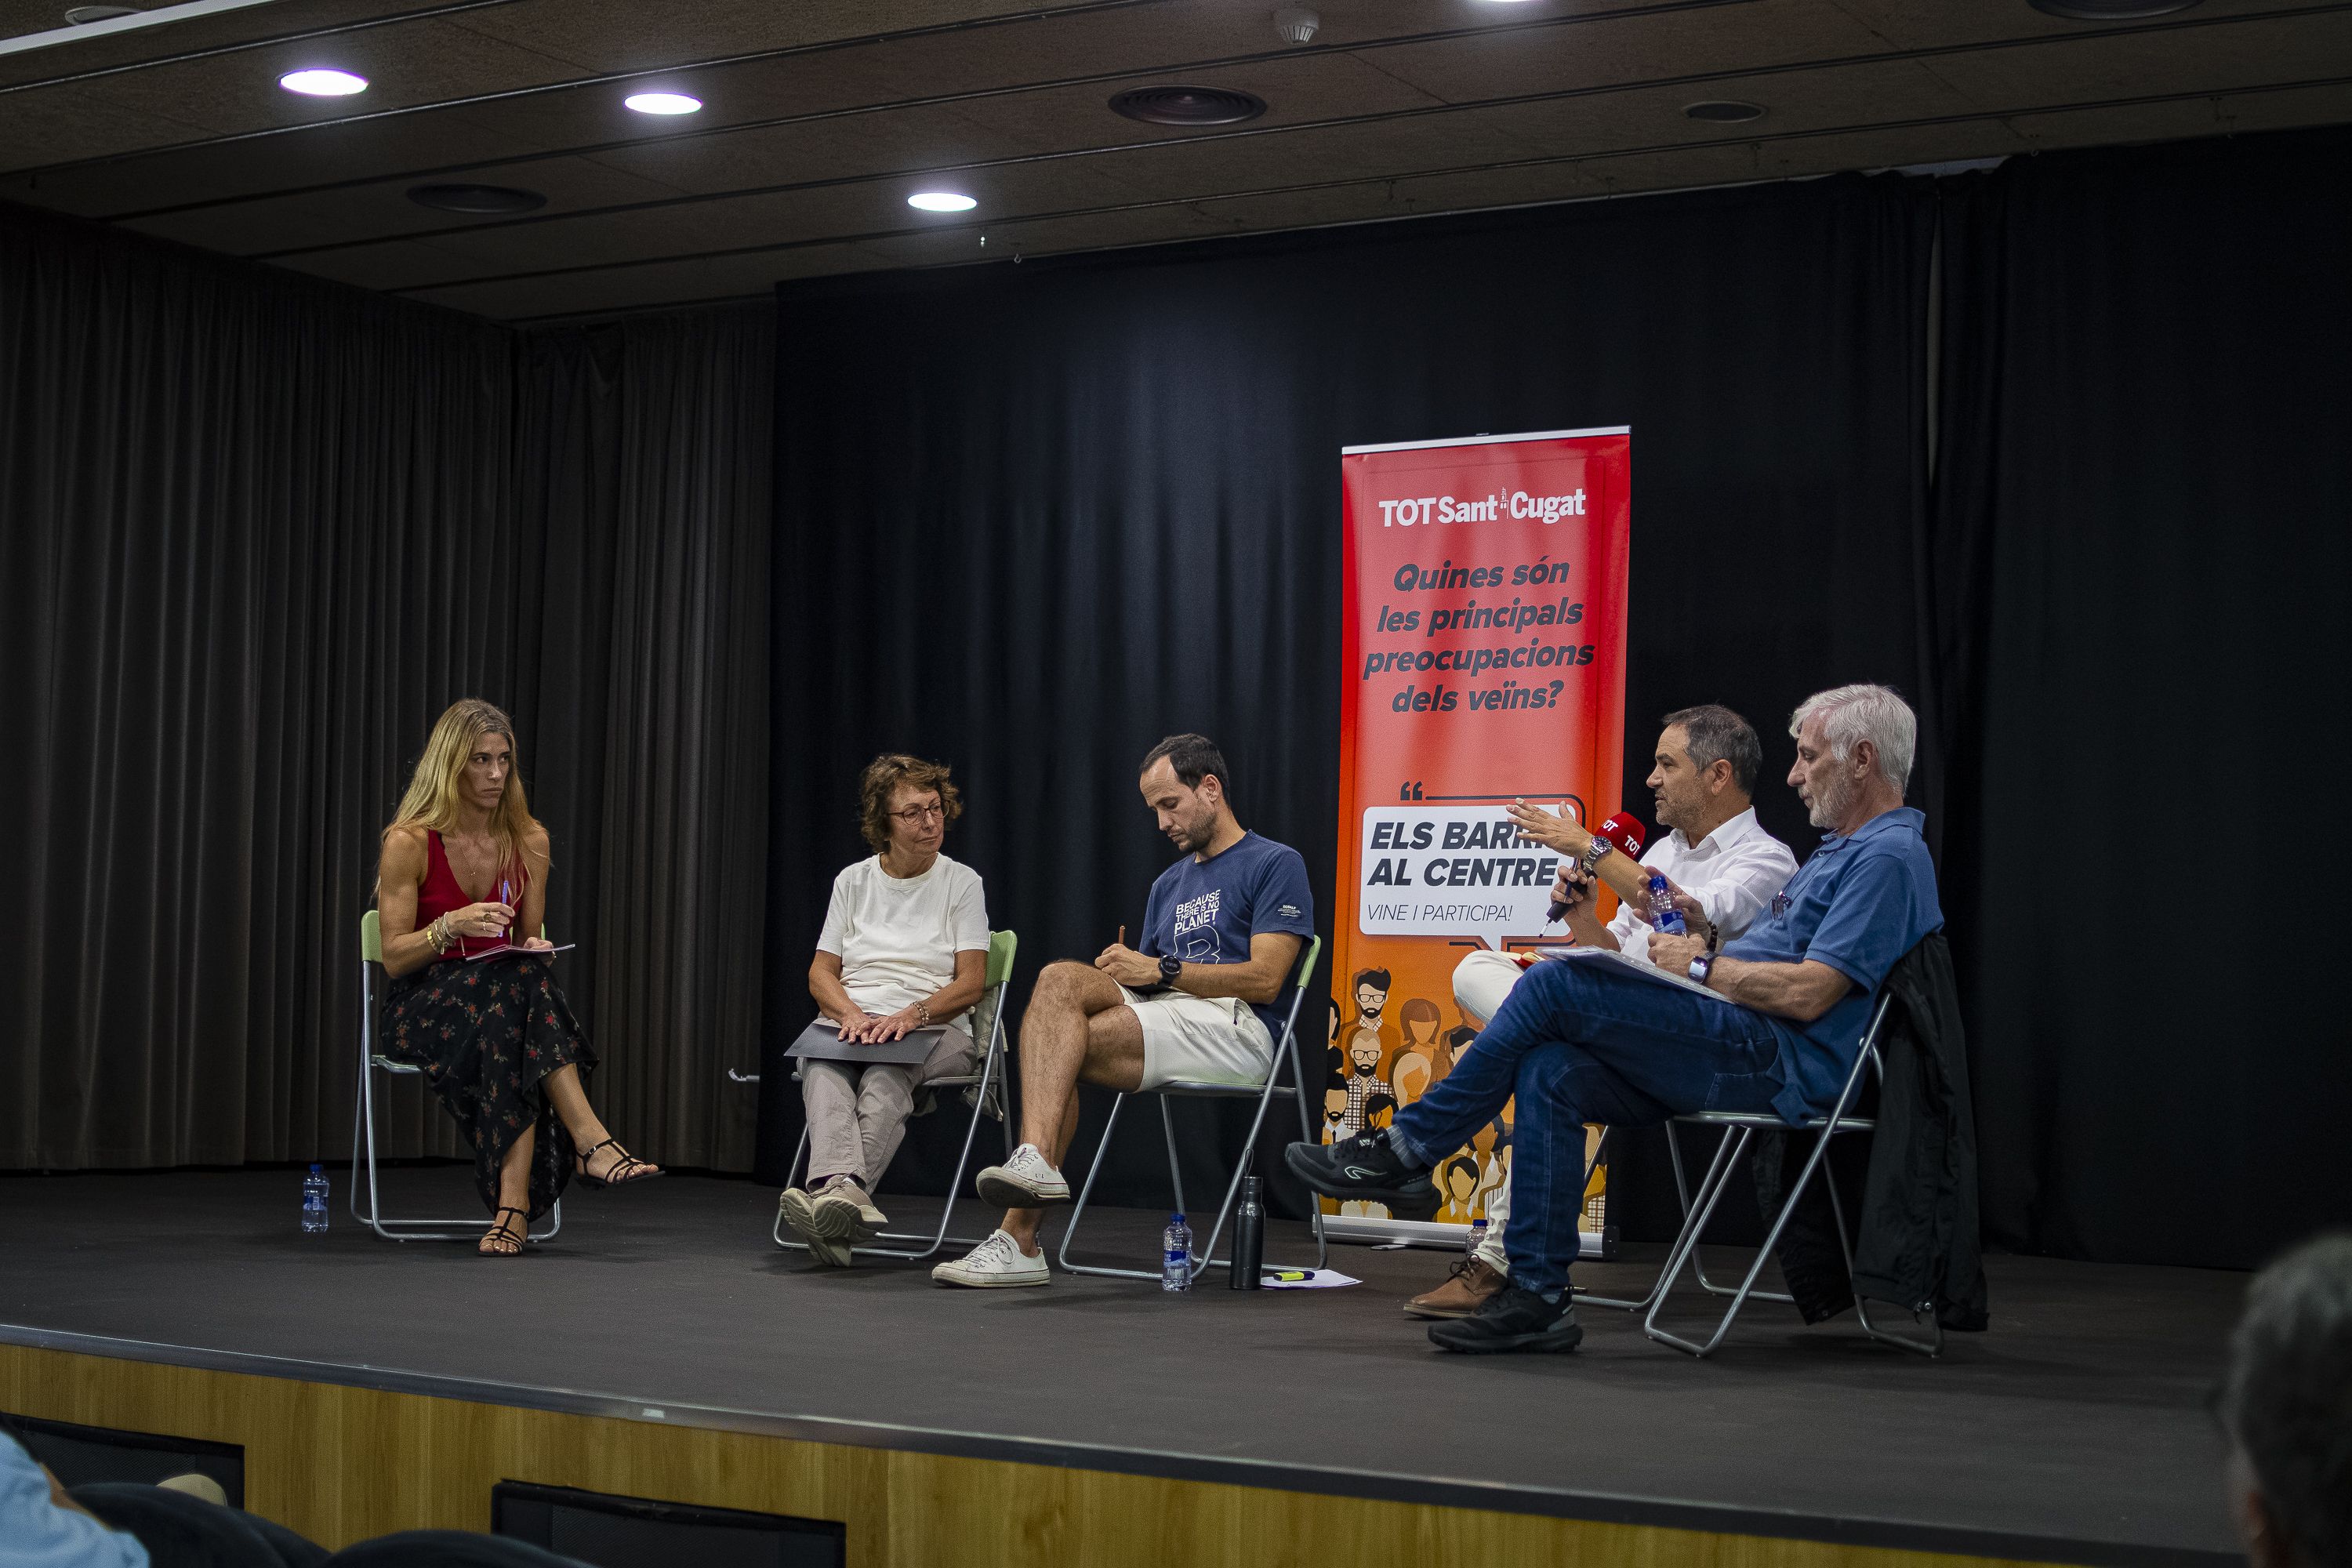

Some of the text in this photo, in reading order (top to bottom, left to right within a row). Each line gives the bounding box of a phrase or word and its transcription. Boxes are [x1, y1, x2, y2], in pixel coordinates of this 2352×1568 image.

[1378, 488, 1586, 527] TOT Sant Cugat
[1393, 555, 1570, 592] Quines són
[1377, 597, 1584, 637] les principals
[1363, 637, 1595, 680] preocupacions
[1392, 680, 1564, 712] dels veïns?
[1370, 821, 1542, 850] ELS BARR
[1367, 858, 1559, 887] AL CENTRE
[1176, 889, 1221, 915] BECAUSE
[1176, 900, 1220, 922] THERE IS NO
[1368, 904, 1513, 922] VINE I PARTICIPA!
[1174, 908, 1219, 935] PLANET
